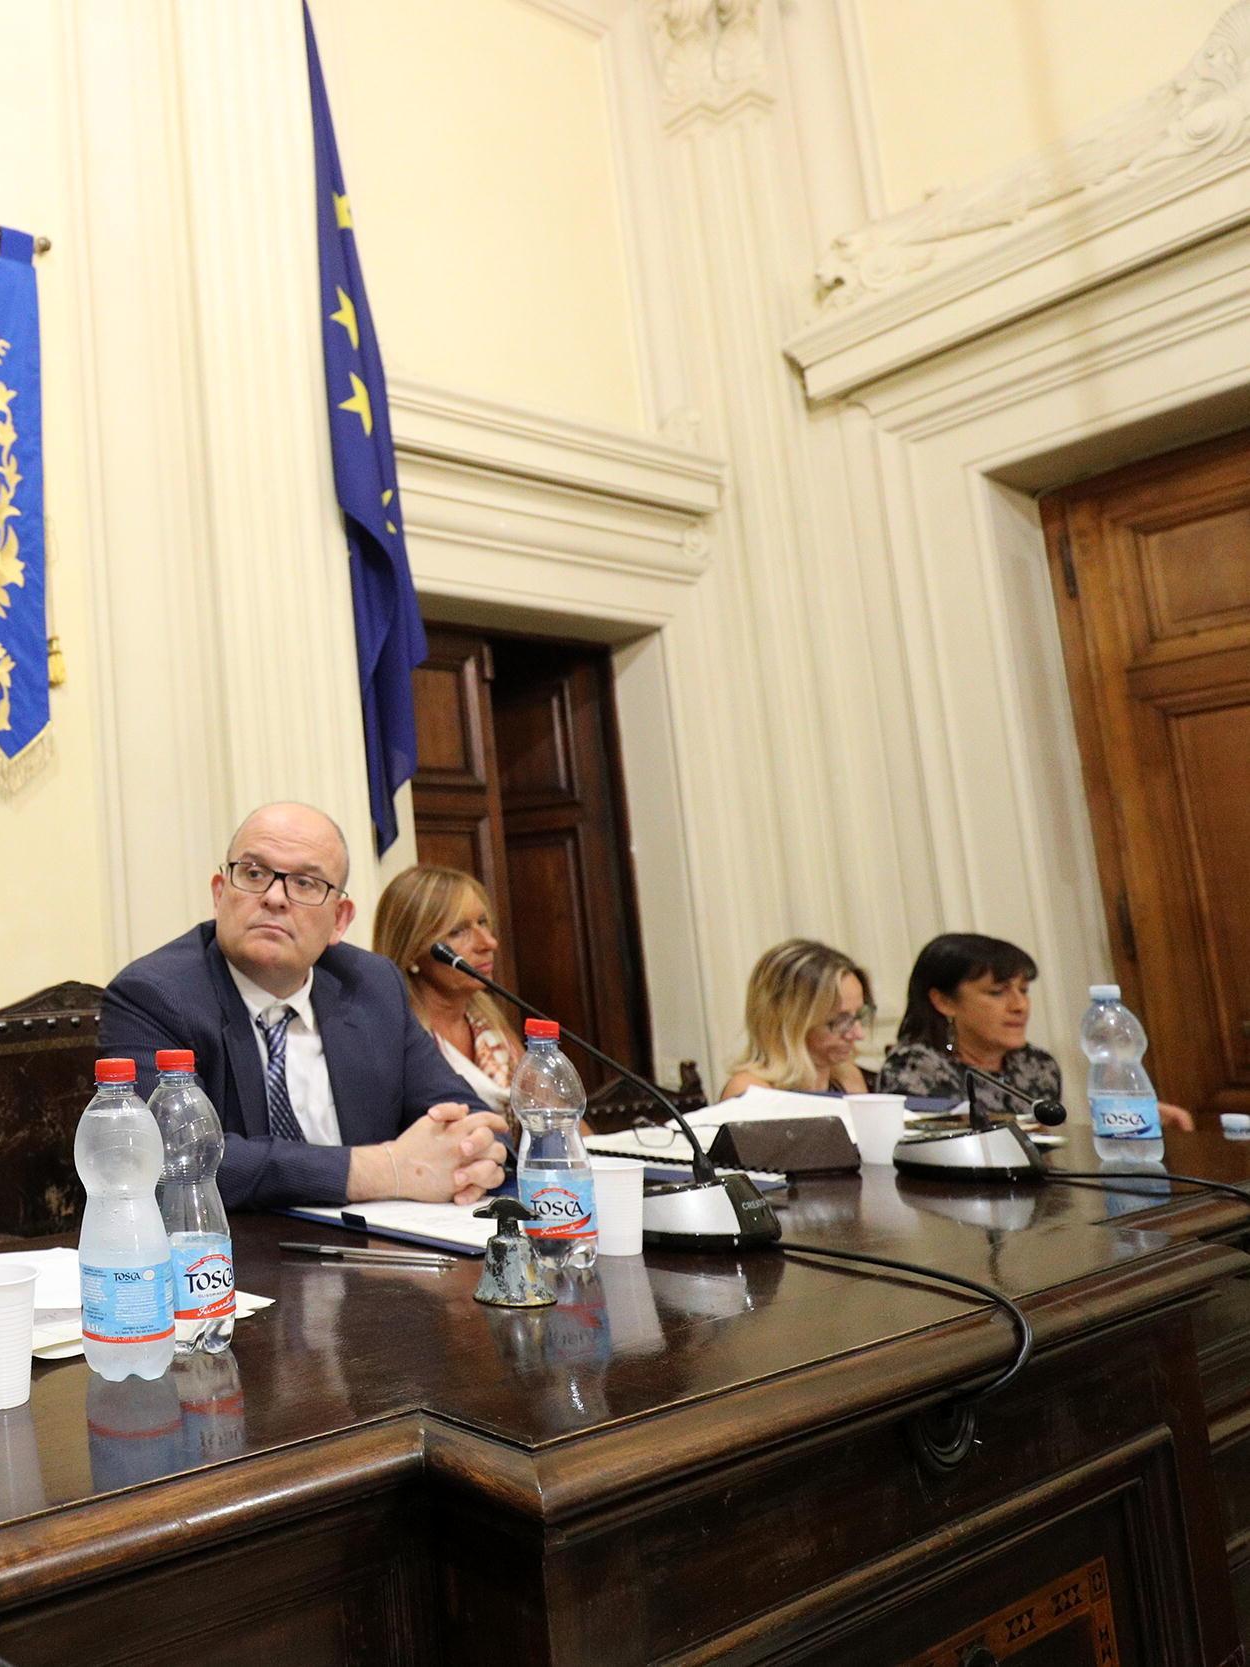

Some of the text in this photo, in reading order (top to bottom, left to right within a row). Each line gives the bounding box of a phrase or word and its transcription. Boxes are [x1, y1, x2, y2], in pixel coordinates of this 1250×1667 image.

[1100, 1112, 1147, 1126] TOSCA
[530, 1200, 584, 1218] TOSCA
[113, 1272, 141, 1282] TOSCA
[183, 1267, 234, 1294] TOSCA
